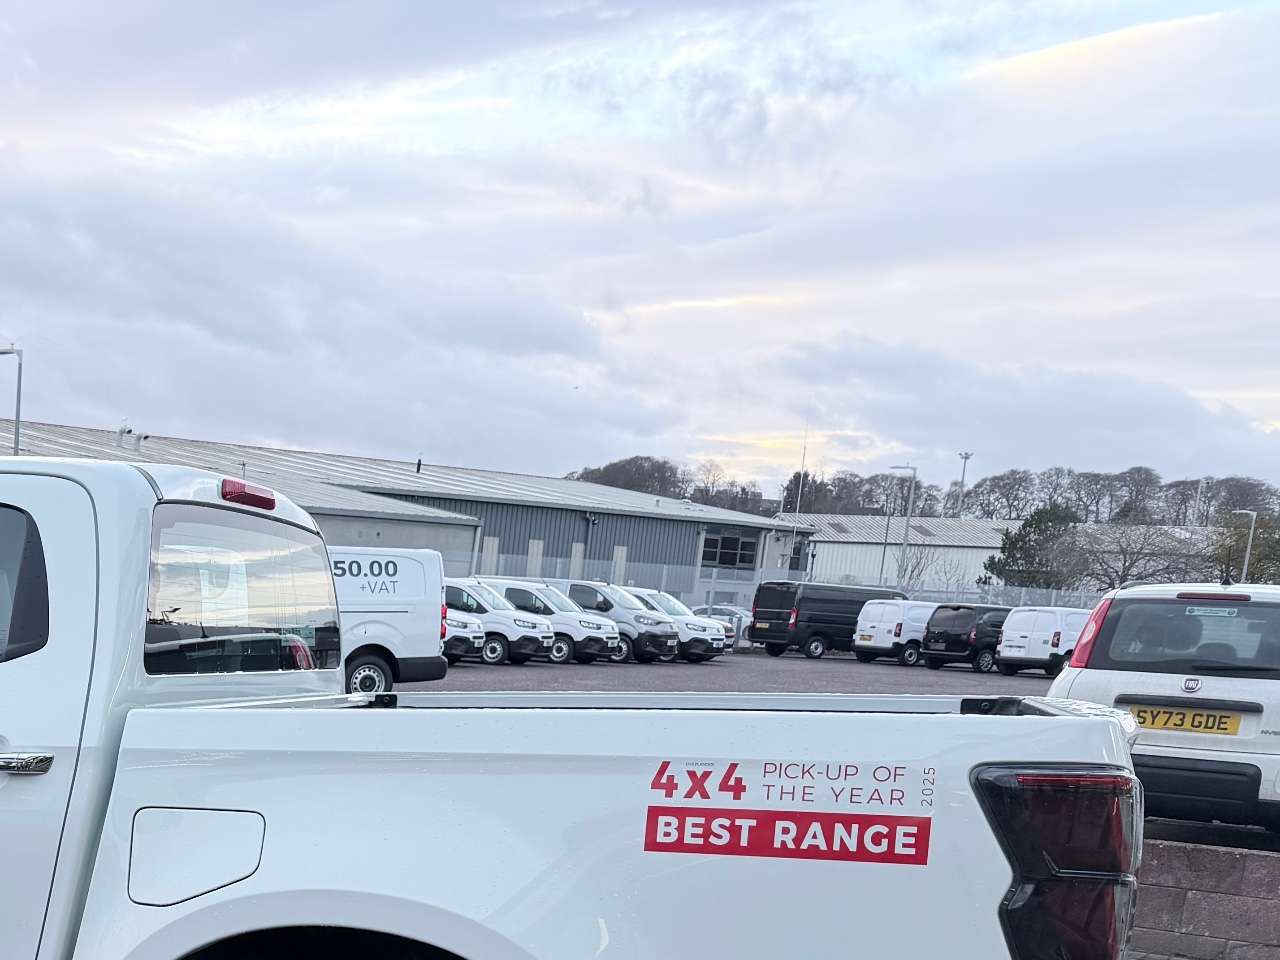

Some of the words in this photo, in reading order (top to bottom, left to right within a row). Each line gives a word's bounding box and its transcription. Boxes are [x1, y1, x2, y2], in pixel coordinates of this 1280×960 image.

[333, 560, 398, 578] 50.00
[359, 580, 399, 595] +VAT
[1136, 709, 1186, 727] SY73
[1190, 712, 1231, 731] GDE
[650, 760, 747, 801] 4x4
[762, 762, 859, 781] PICK-UP
[872, 765, 907, 783] OF
[762, 784, 816, 803] THE
[830, 786, 905, 806] YEAR
[920, 767, 936, 807] 2025
[656, 815, 757, 847] BEST
[773, 820, 918, 855] RANGE
